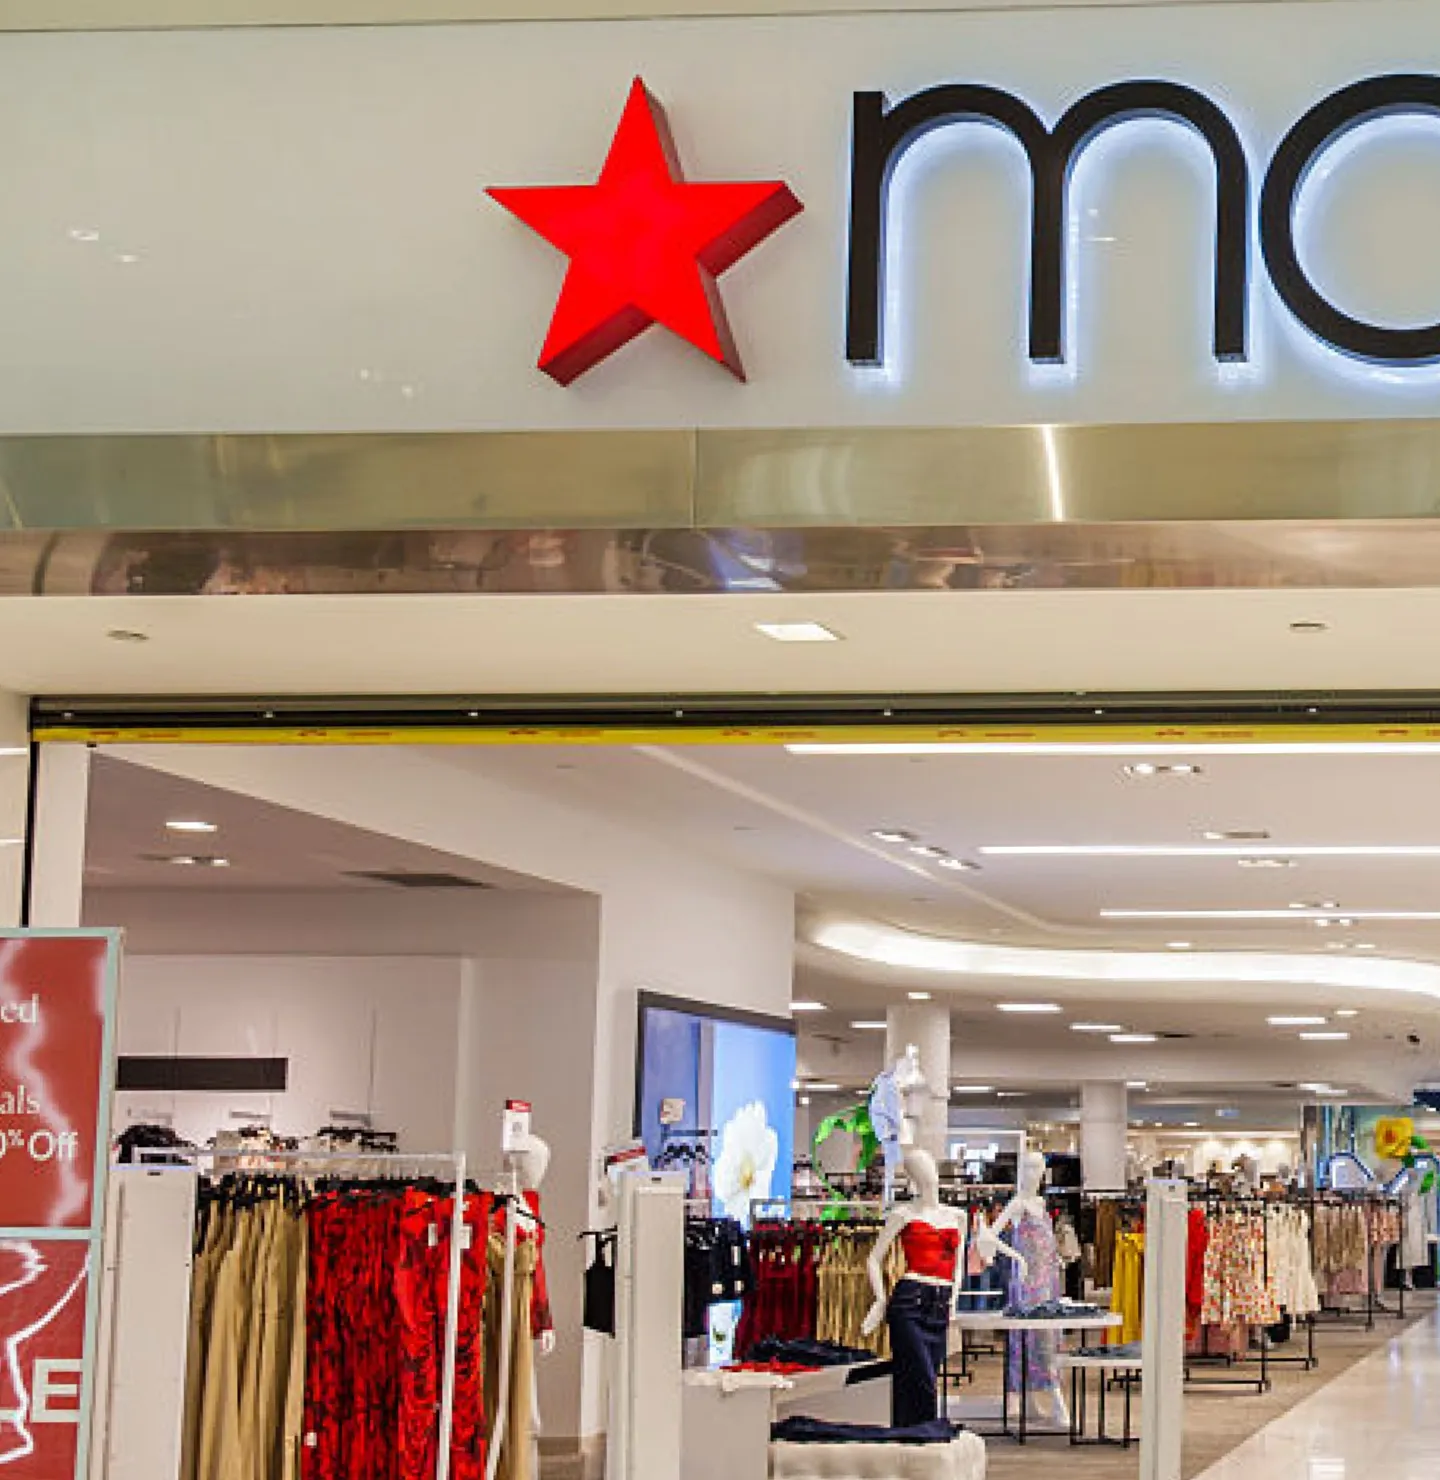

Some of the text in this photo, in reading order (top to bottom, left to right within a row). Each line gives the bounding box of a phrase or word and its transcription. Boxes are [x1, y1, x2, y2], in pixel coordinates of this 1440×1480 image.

[1, 993, 39, 1023] ed
[0, 1085, 40, 1114] als
[28, 1129, 78, 1161] Off
[0, 1359, 83, 1423] E
